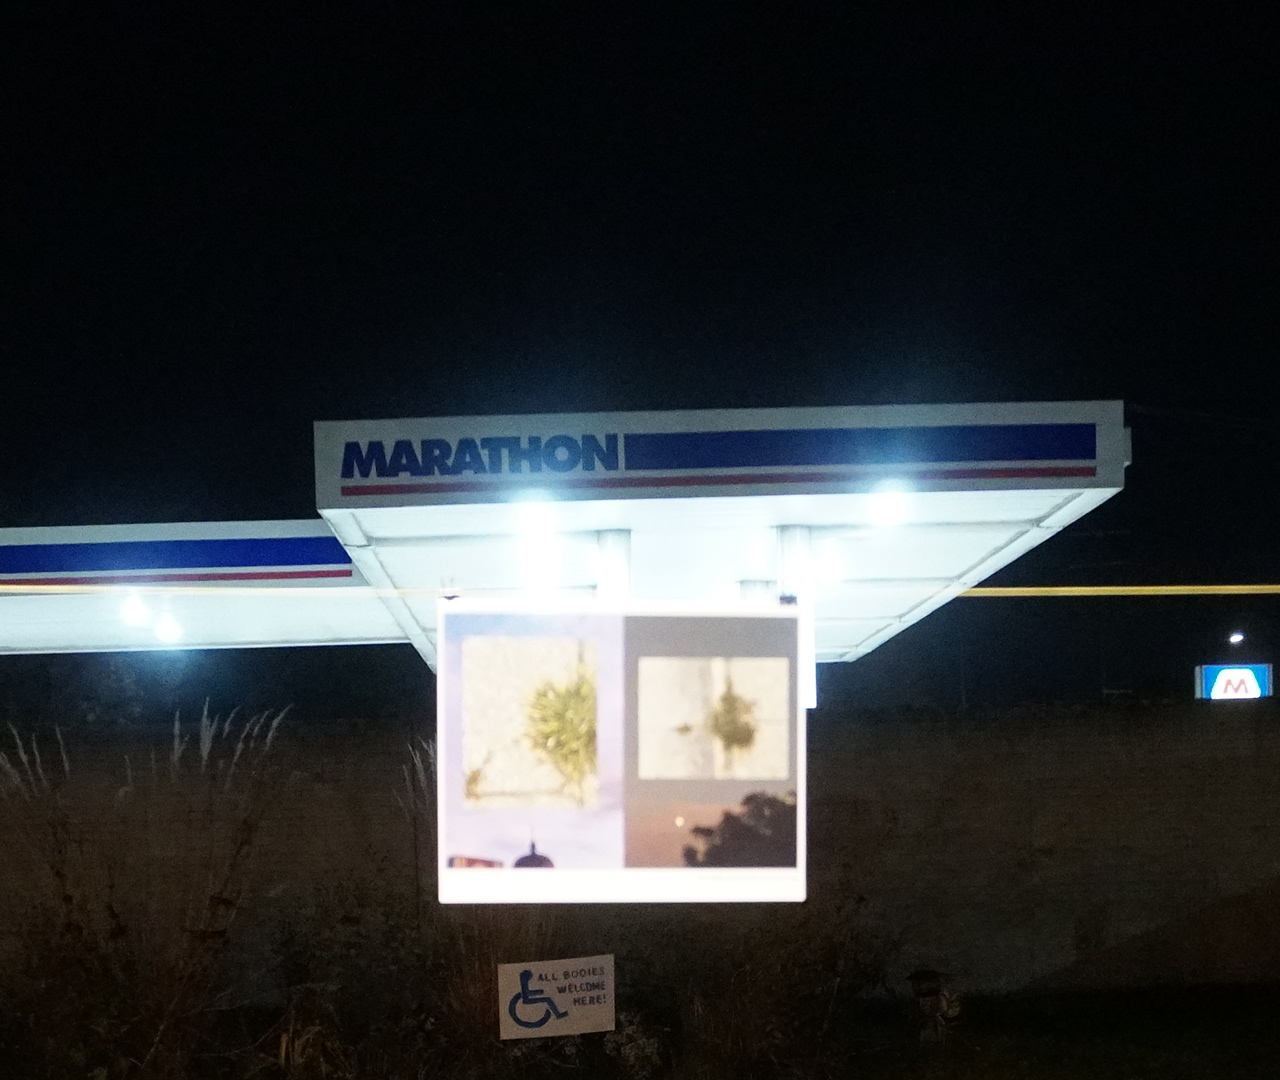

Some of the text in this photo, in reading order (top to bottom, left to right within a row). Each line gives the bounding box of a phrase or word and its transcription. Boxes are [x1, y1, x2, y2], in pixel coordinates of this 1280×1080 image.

[341, 433, 619, 479] MARATHON
[1223, 678, 1249, 694] M
[538, 966, 605, 982] ALL BODIES
[556, 980, 606, 994] WELCOME
[573, 994, 607, 1007] HERE!
